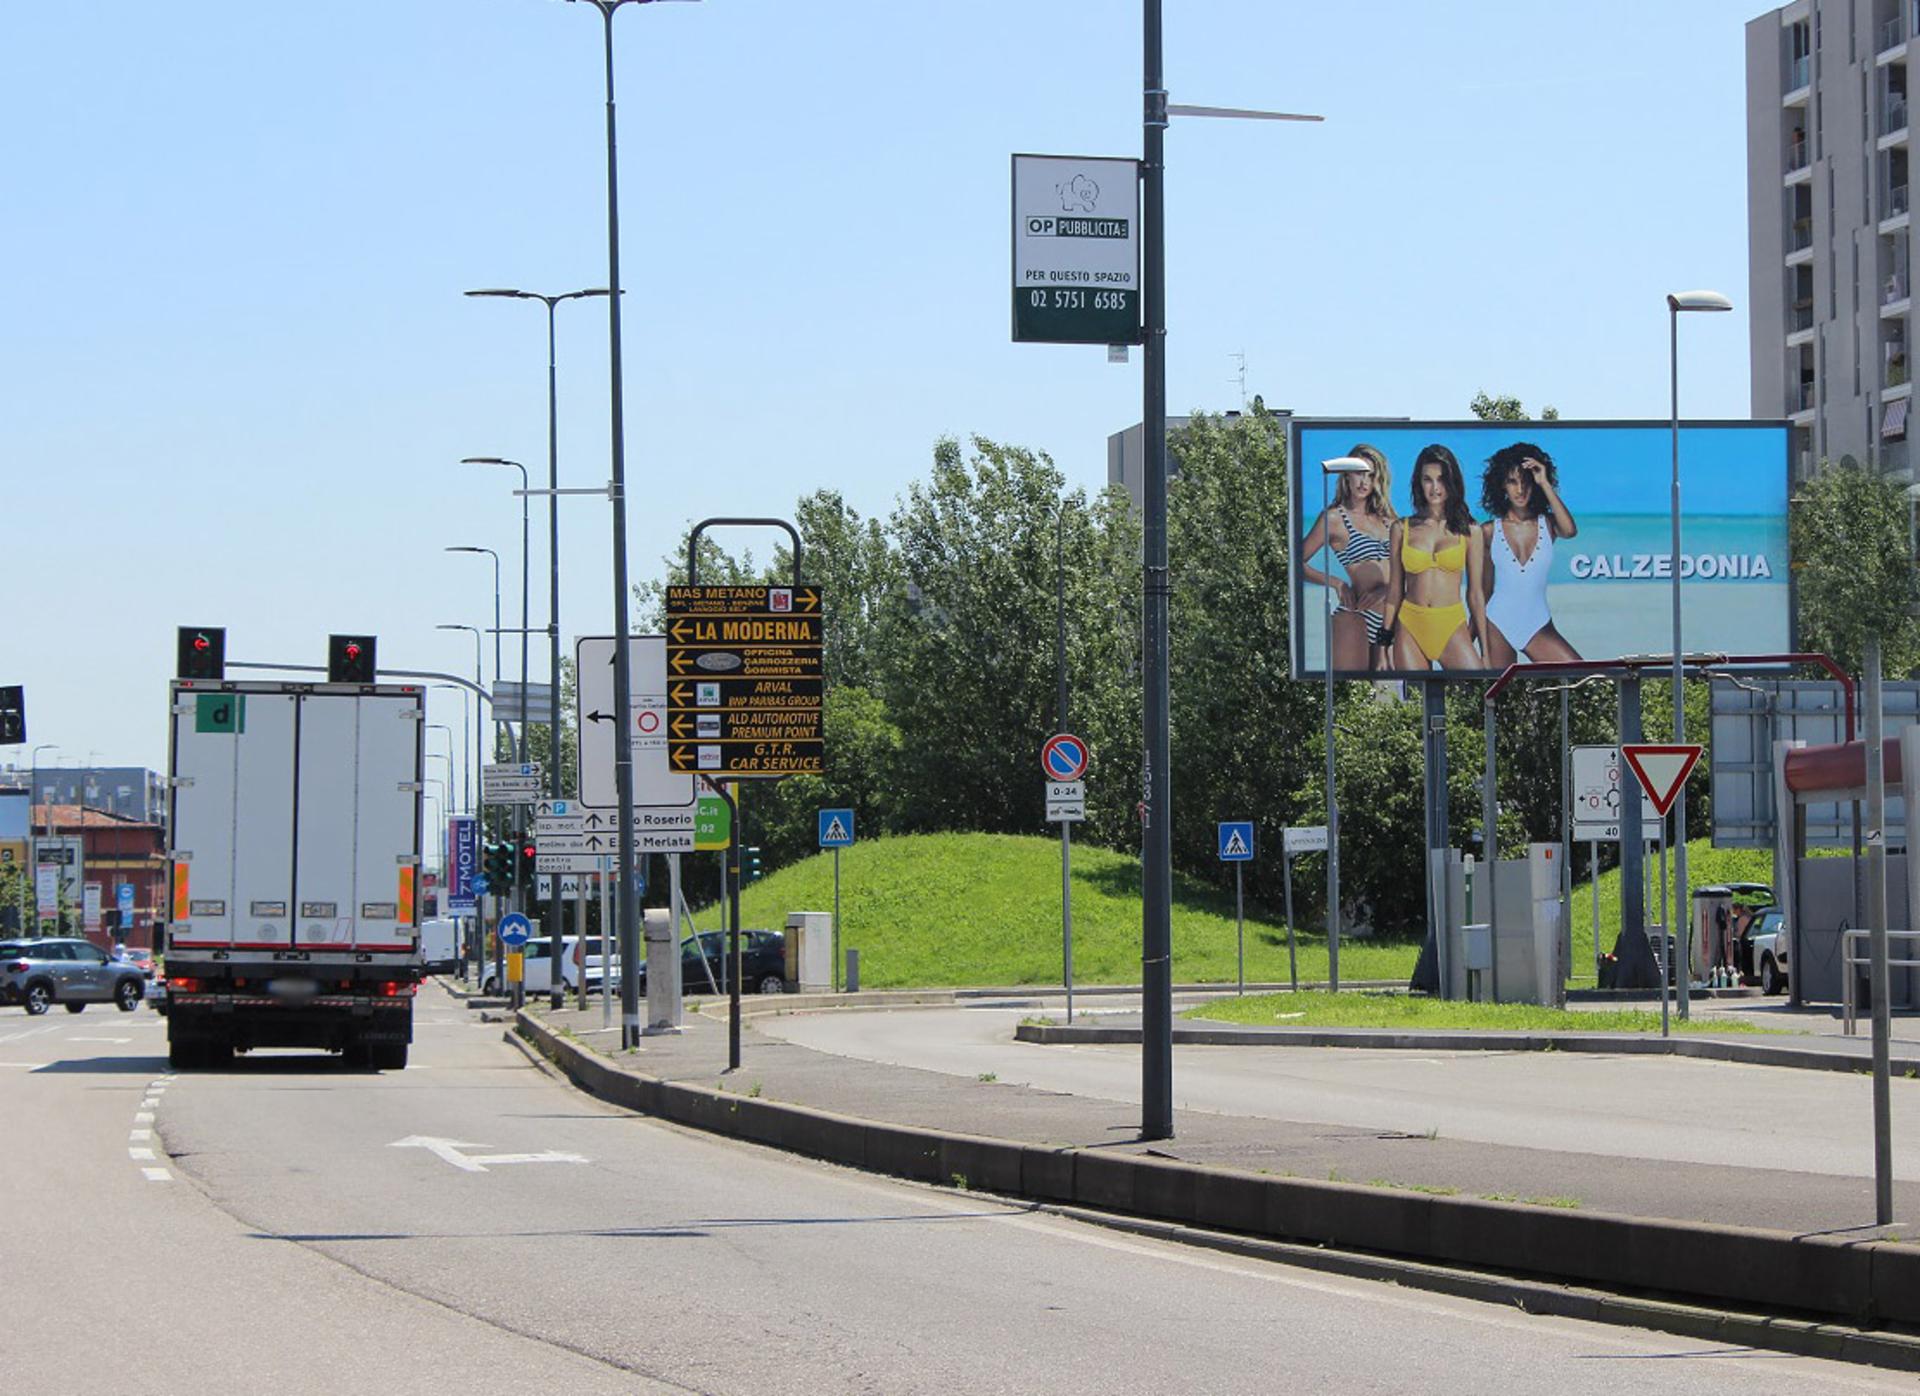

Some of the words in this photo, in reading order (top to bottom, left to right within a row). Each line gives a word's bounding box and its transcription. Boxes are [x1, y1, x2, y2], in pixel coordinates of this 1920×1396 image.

[1029, 219, 1053, 233] OP
[1026, 270, 1045, 281] PER
[1050, 271, 1090, 282] QUESTO
[1094, 272, 1131, 283] SPAZIO
[1031, 290, 1047, 307] 02
[1055, 291, 1085, 308] 5751
[1094, 291, 1126, 309] 6585
[1569, 553, 1772, 579] CALZEDONIA
[669, 587, 702, 599] MAS
[706, 587, 767, 599] METANO
[695, 622, 717, 641] LA
[723, 621, 811, 641] MODERNA
[744, 657, 818, 665] CARROZZERIA
[744, 666, 802, 674] GOMMISTA
[755, 681, 793, 693] ARVAL
[788, 695, 821, 706] GROUP
[213, 703, 229, 725] d
[727, 713, 748, 725] ALD
[751, 712, 819, 725] AUTOMOTIVE
[732, 727, 781, 738] PREMIUM
[785, 726, 817, 738] POINT
[754, 743, 796, 756] G.T.R.
[730, 757, 759, 770] CAR
[762, 757, 821, 770] SERVICE
[609, 815, 640, 825] Eo
[644, 813, 692, 825] Roserio
[1605, 827, 1618, 837] 40
[609, 837, 640, 848] Eo
